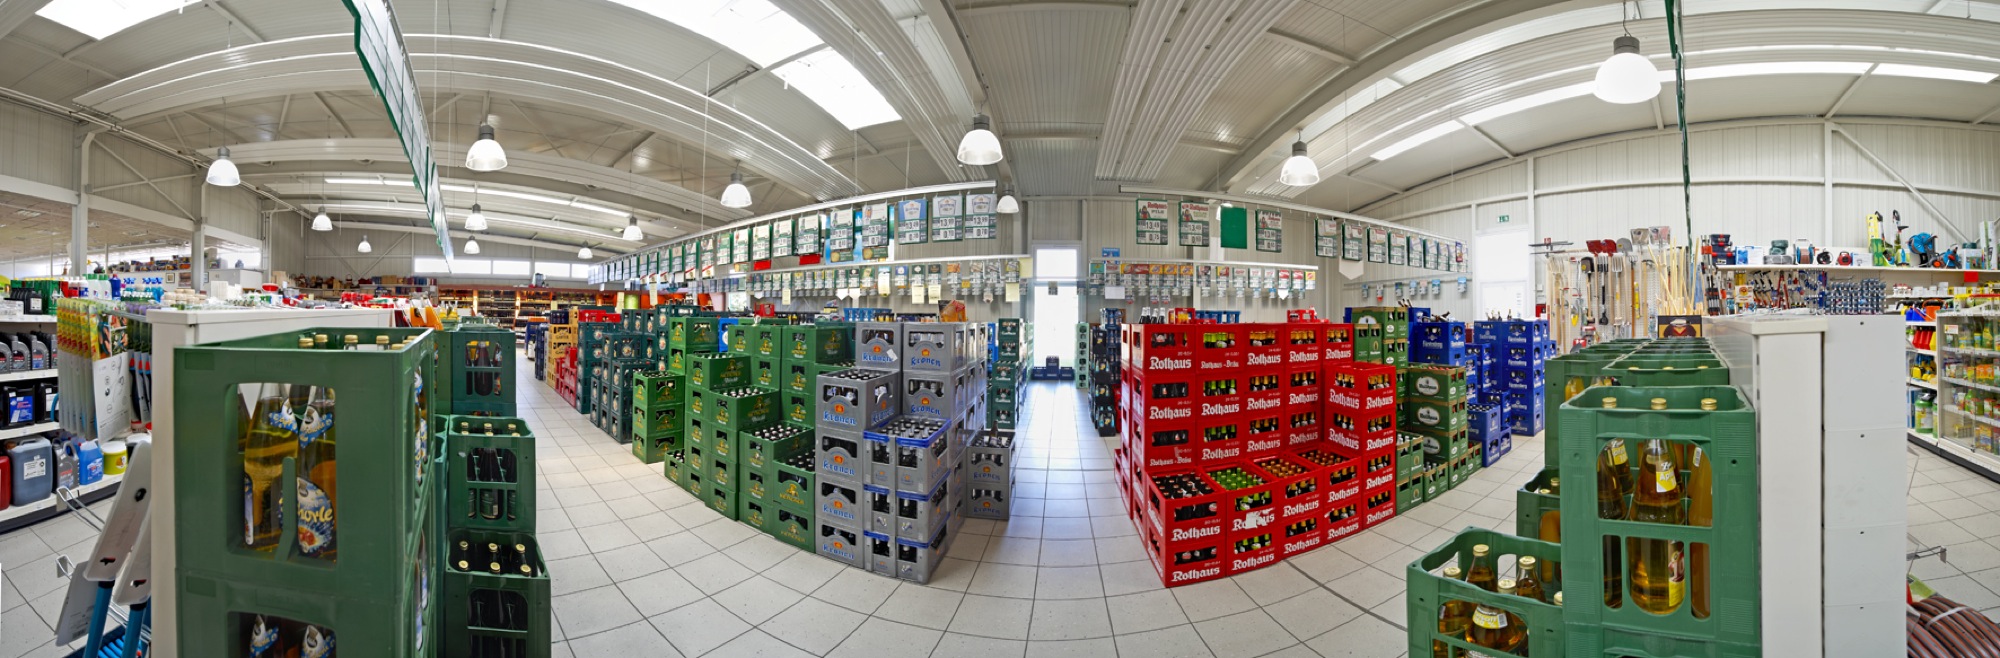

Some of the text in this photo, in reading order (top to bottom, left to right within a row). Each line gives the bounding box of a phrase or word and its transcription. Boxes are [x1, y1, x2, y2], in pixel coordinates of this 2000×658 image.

[1247, 352, 1281, 366] Rothaus
[1289, 351, 1318, 363] Rothaus
[1325, 348, 1351, 360] Rothaus
[1149, 356, 1192, 371] Rothaus
[1247, 397, 1281, 410] Rothaus
[1289, 393, 1318, 405] Rothaus
[1329, 388, 1360, 410] Rothaus
[1365, 396, 1393, 410] Rothaus
[1149, 406, 1192, 420] Rothaus
[1201, 403, 1240, 416] Rothaus
[1247, 439, 1281, 452] Rothaus
[1289, 432, 1318, 445] Rothaus
[1328, 428, 1359, 450] Rothaus
[1366, 436, 1394, 451] Rothaus
[1201, 447, 1240, 460] Rothaus
[1365, 473, 1393, 490] Rothaus
[1327, 486, 1359, 503] Rothaus
[1282, 500, 1319, 517] Rothaus
[1366, 508, 1393, 525] Rothaus
[1171, 525, 1220, 541] Rothaus
[1327, 522, 1359, 539] Rothaus
[1284, 537, 1320, 554] Rothaus
[1232, 553, 1275, 571] Rothaus
[1171, 567, 1220, 582] Rothaus
